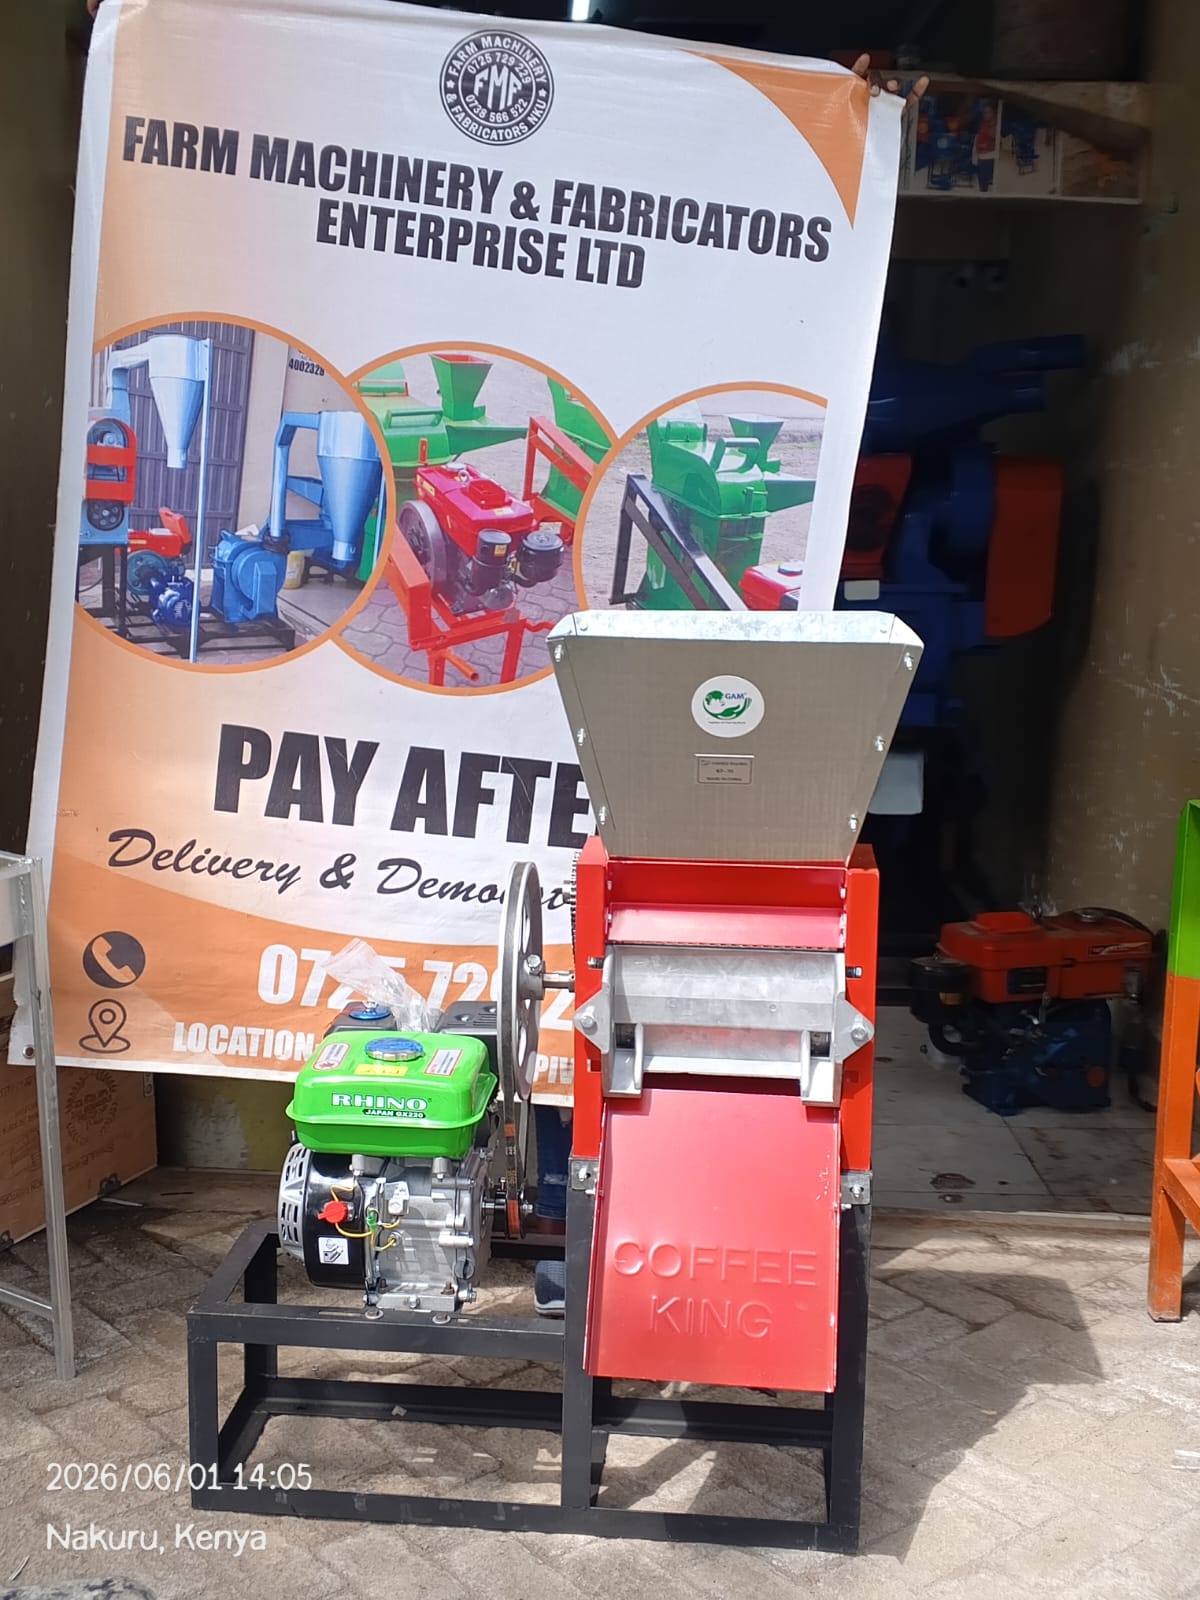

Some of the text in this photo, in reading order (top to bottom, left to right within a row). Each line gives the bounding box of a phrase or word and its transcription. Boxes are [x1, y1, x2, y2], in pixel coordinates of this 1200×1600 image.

[448, 36, 548, 84] FARM MACHINERY
[467, 52, 531, 84] 0725 729 229
[451, 105, 529, 140] FABRICATORS
[527, 100, 546, 125] NKU
[465, 94, 528, 123] 0738 566 522
[123, 115, 832, 262] FARM MACHINERY & FABRICATORS
[316, 198, 646, 289] ENTERPRISE LTD
[213, 723, 380, 826] PAY
[108, 828, 302, 894] Delivery
[319, 853, 357, 890] &
[173, 1022, 319, 1061] LOCATION
[332, 1093, 428, 1111] RHINO
[614, 1241, 817, 1286] COFFEE
[651, 1295, 772, 1338] KING
